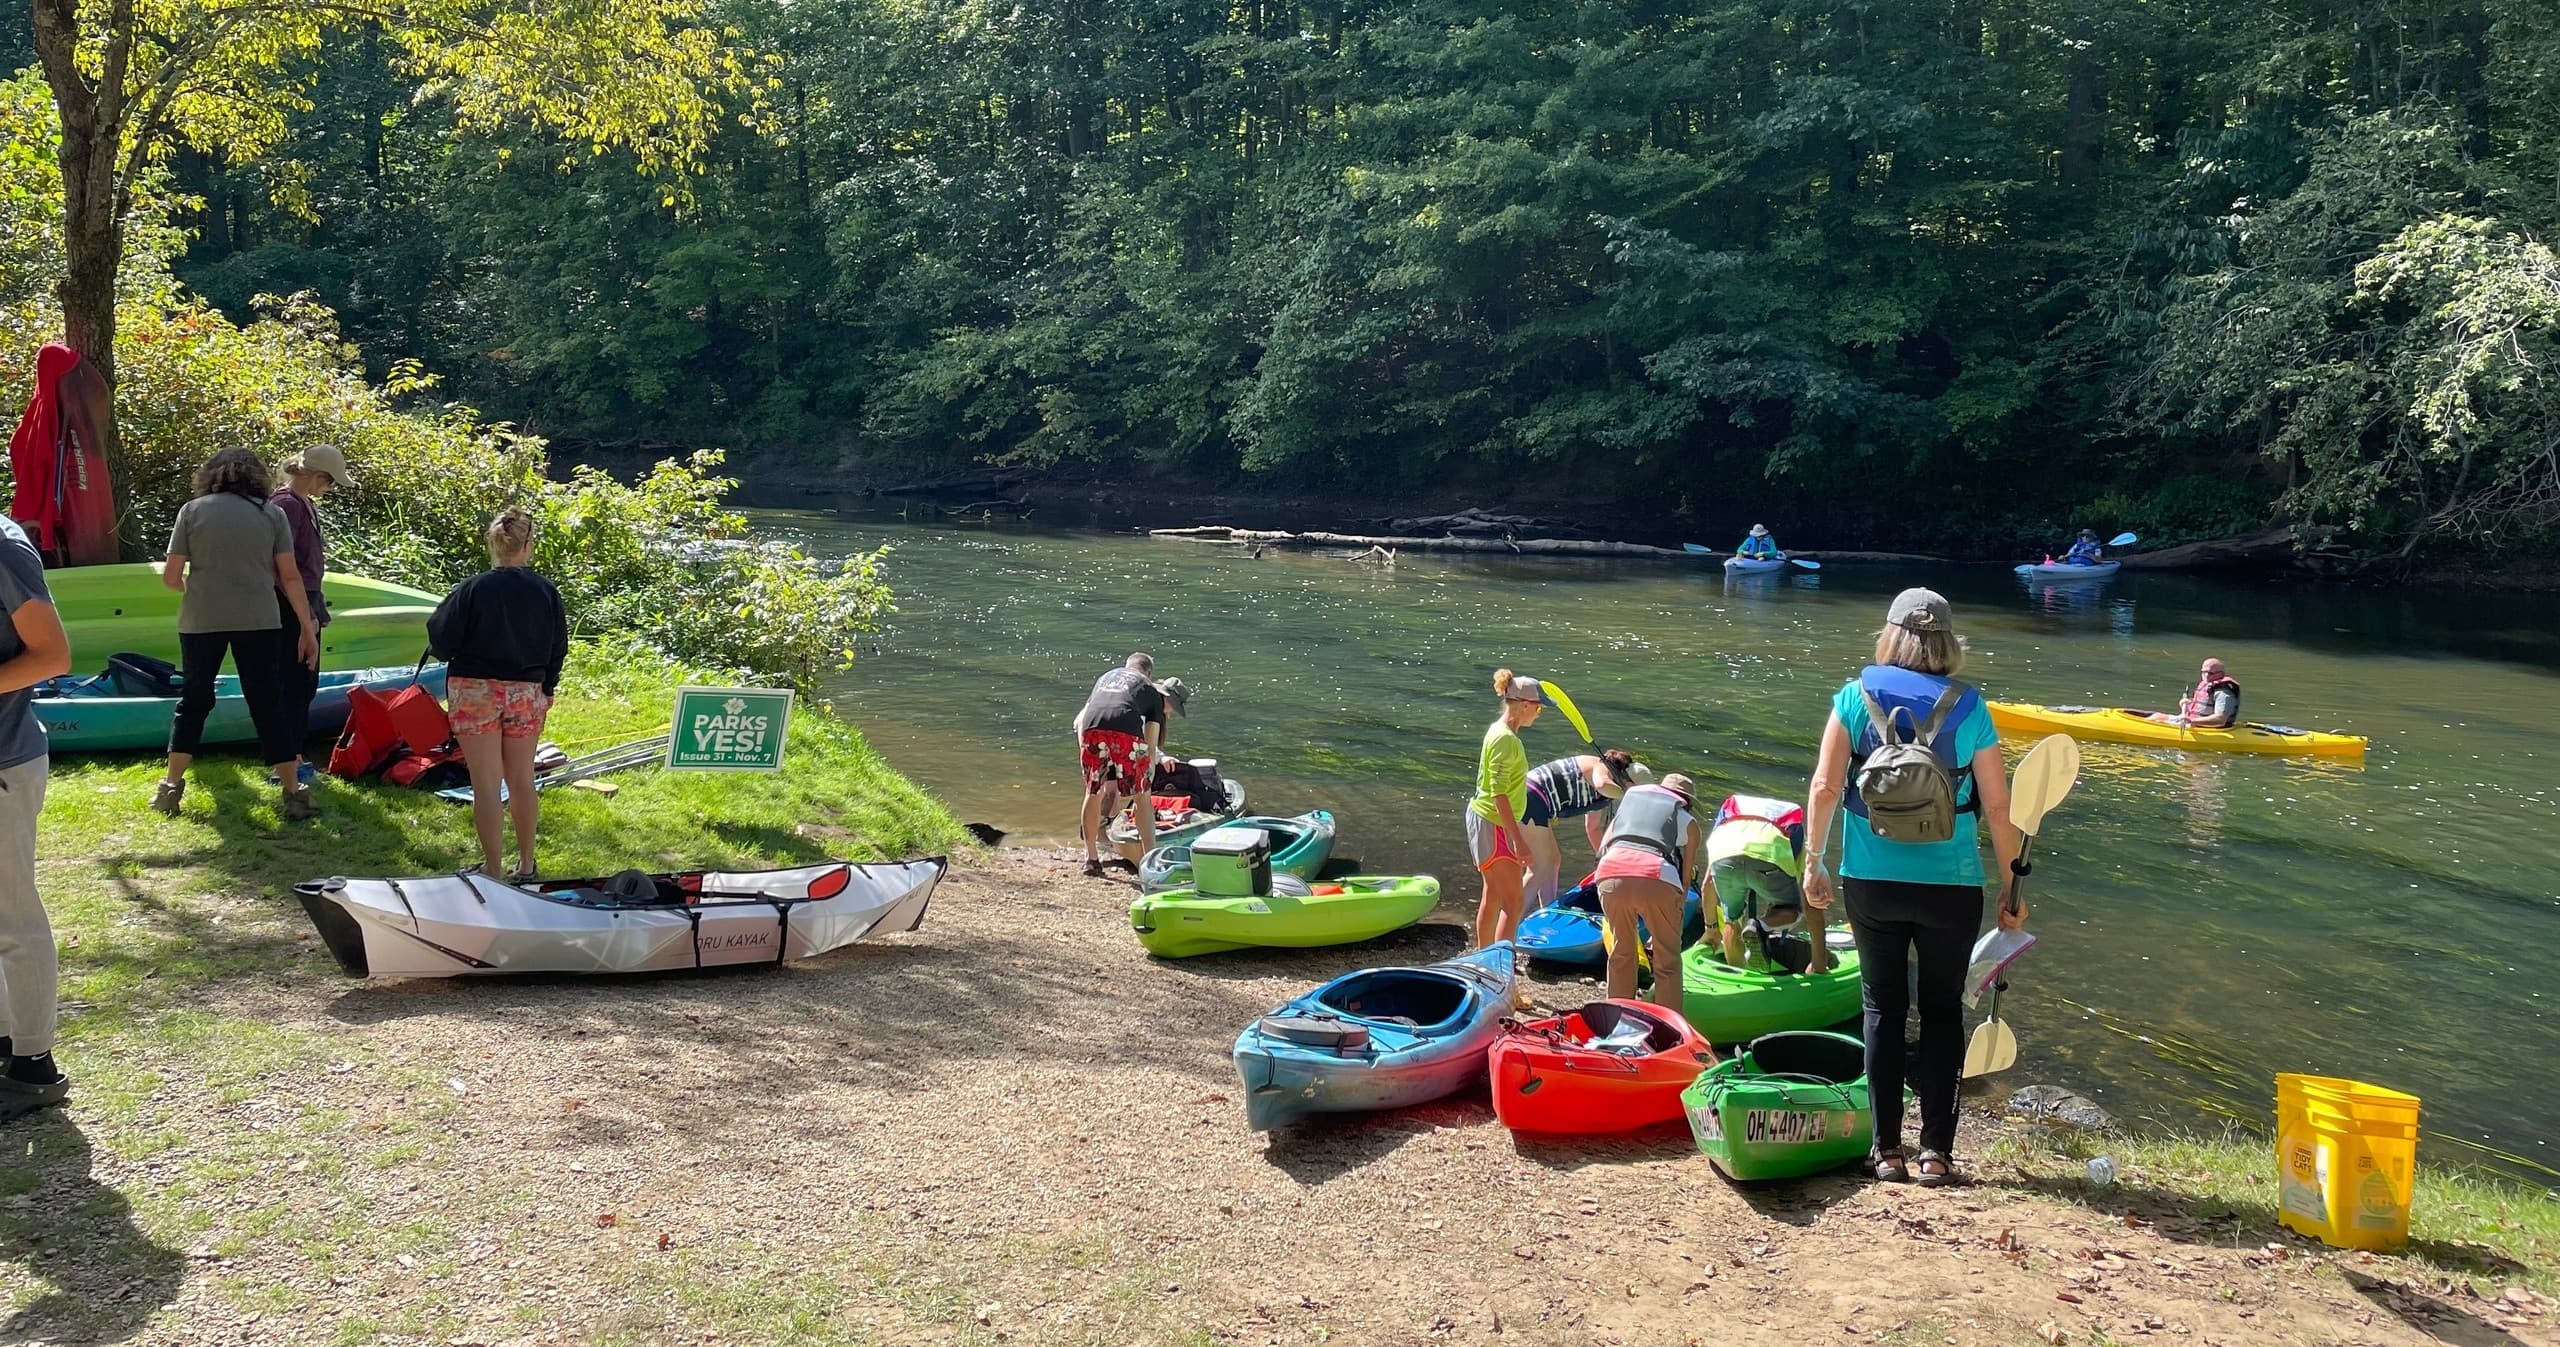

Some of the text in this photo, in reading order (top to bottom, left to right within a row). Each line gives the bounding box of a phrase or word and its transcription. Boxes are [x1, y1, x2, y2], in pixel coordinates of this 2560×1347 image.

[694, 714, 768, 730] PARKS
[693, 729, 766, 753] YES!
[680, 751, 711, 761] Issue
[713, 752, 724, 761] 31
[735, 753, 760, 761] Nov.
[763, 753, 771, 761] 7
[726, 932, 769, 948] KAYAK
[1747, 1110, 1767, 1141] OH
[1769, 1111, 1807, 1141] 4407
[2294, 1152, 2311, 1163] TIDY
[2293, 1160, 2312, 1173] CATS
